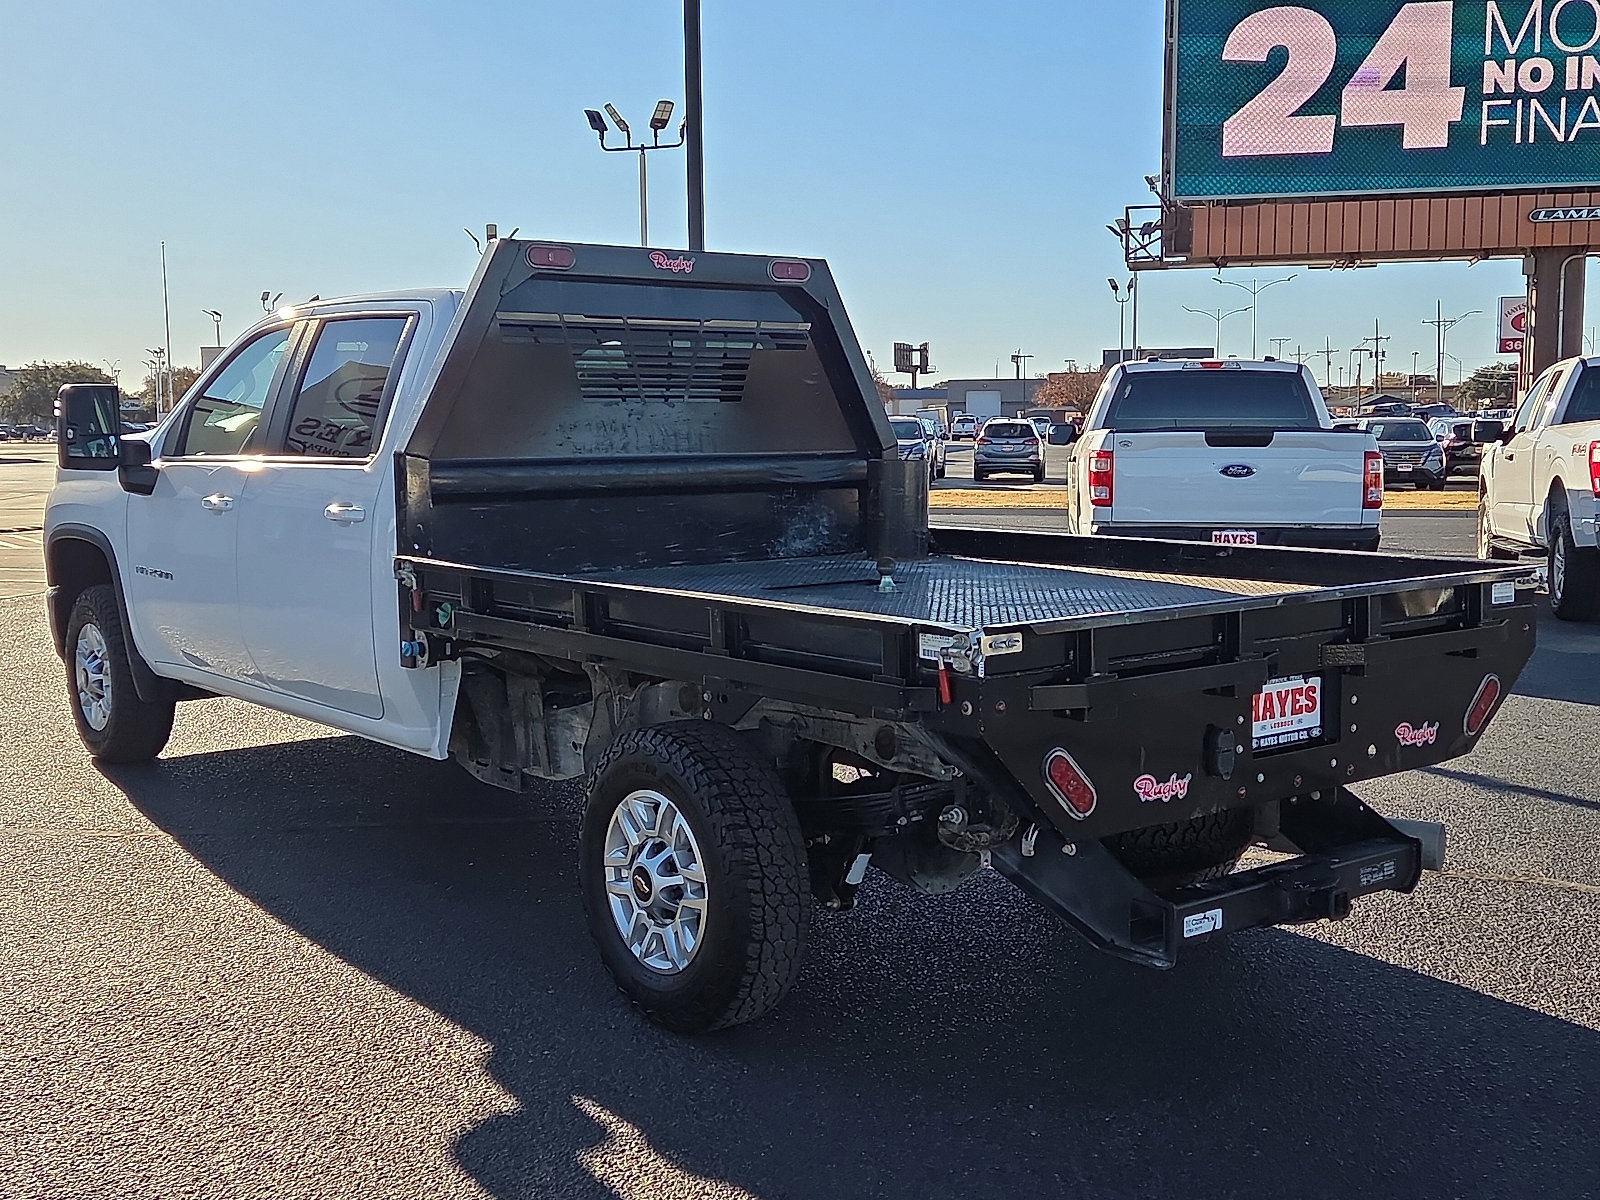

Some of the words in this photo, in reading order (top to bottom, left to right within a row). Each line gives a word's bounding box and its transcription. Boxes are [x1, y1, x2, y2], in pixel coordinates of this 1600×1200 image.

[1485, 0, 1600, 55] MO
[1222, 1, 1466, 157] 24
[1482, 57, 1554, 94] NO
[1564, 55, 1600, 91] IN
[1481, 96, 1600, 146] FINA
[649, 251, 696, 273] Rugby
[1213, 534, 1255, 545] HAYES
[1260, 735, 1278, 747] HAYES
[1394, 720, 1440, 747] Rugby
[1134, 773, 1192, 802] Rugby
